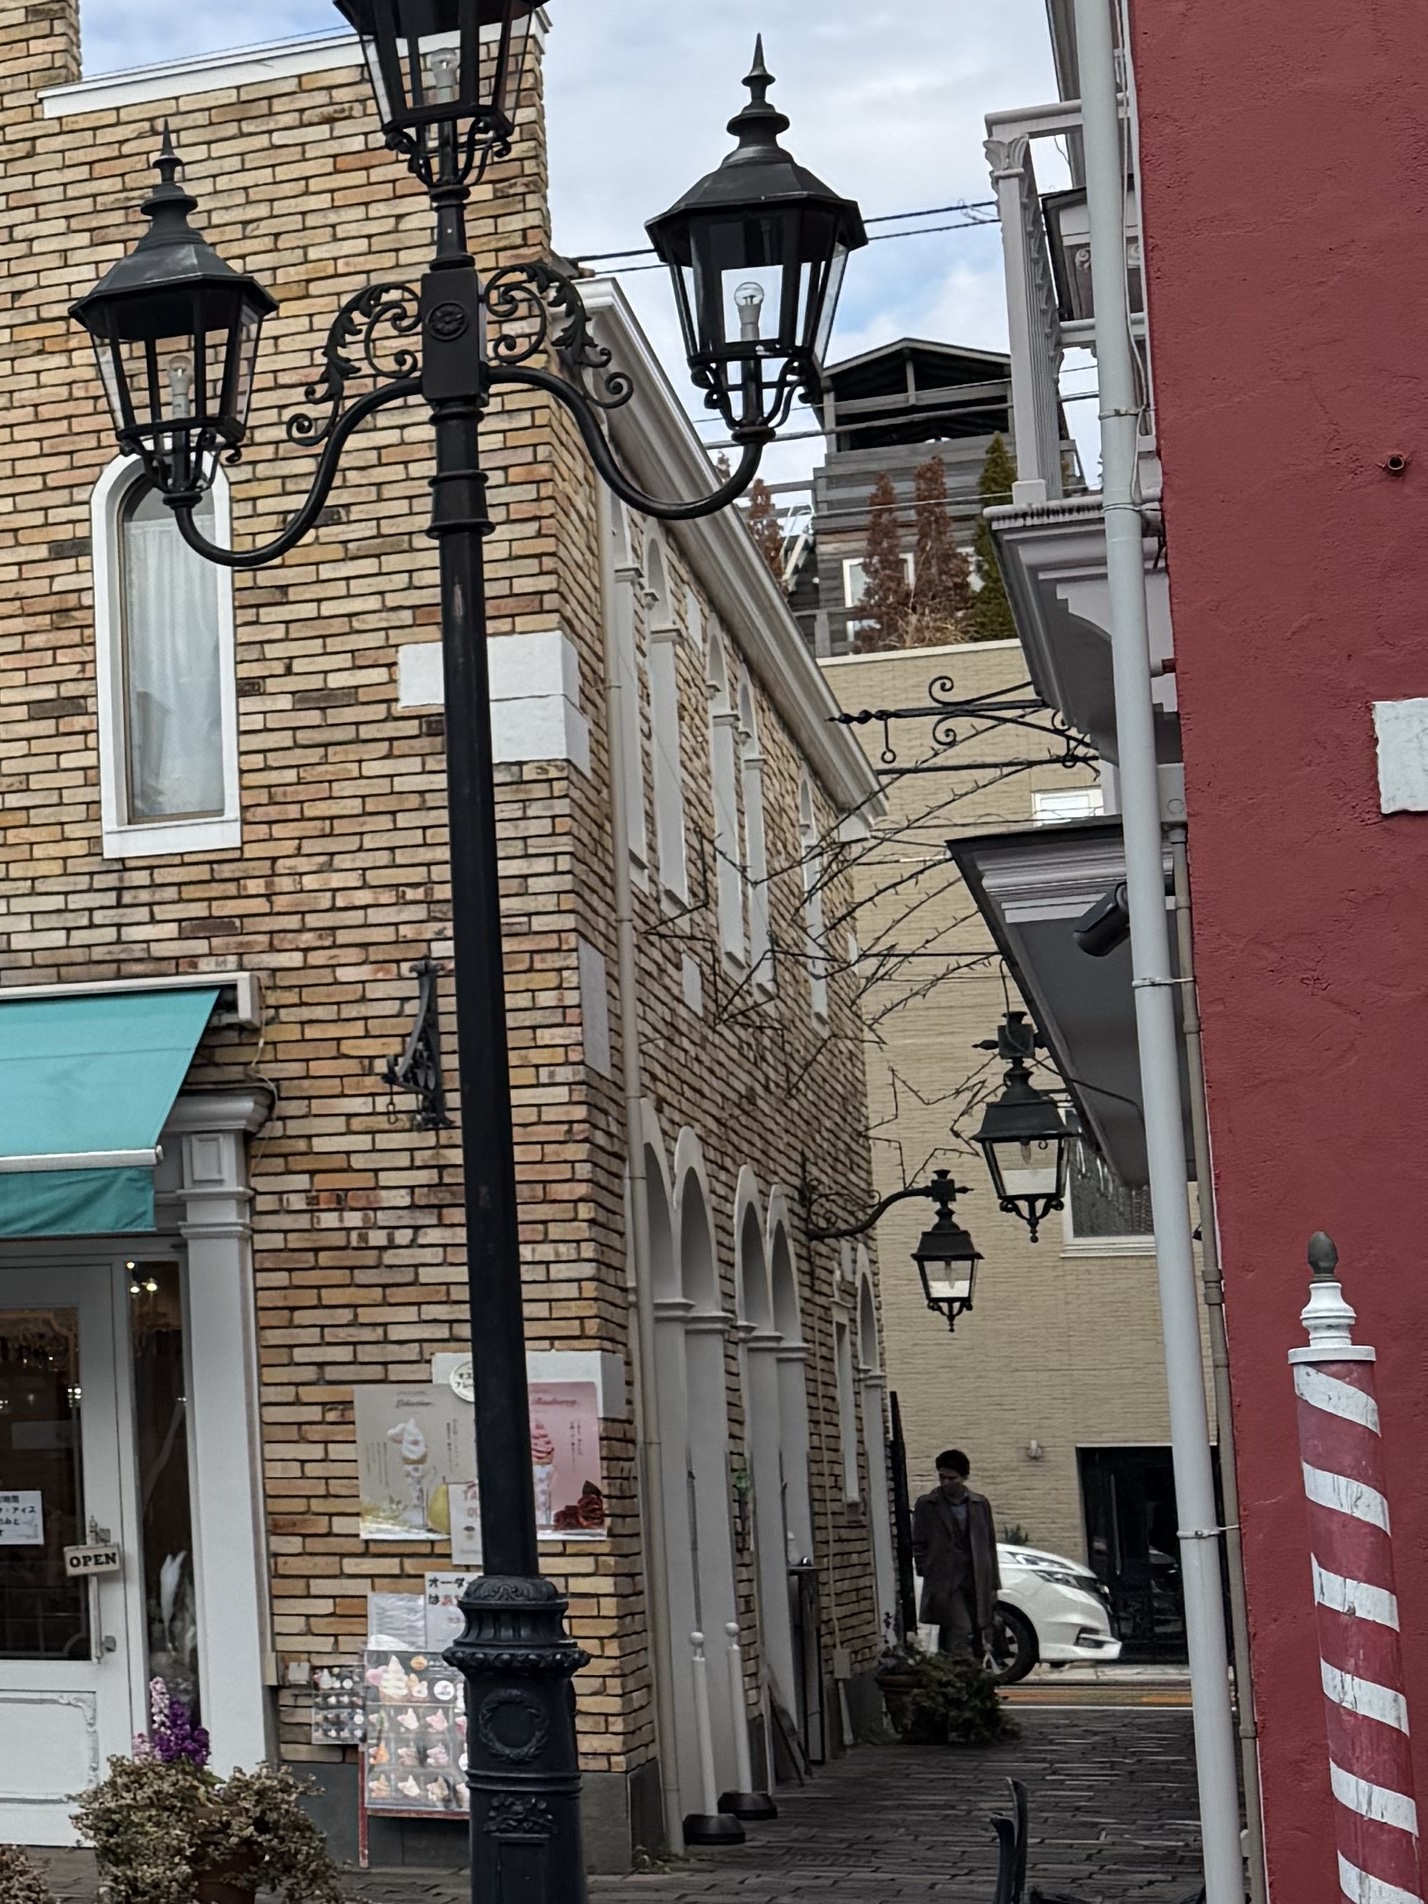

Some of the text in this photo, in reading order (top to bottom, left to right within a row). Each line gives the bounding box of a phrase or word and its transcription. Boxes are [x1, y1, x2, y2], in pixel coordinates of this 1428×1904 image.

[461, 1489, 478, 1500] TA
[69, 1552, 117, 1568] OPEN
[427, 1576, 469, 1589] オーダ
